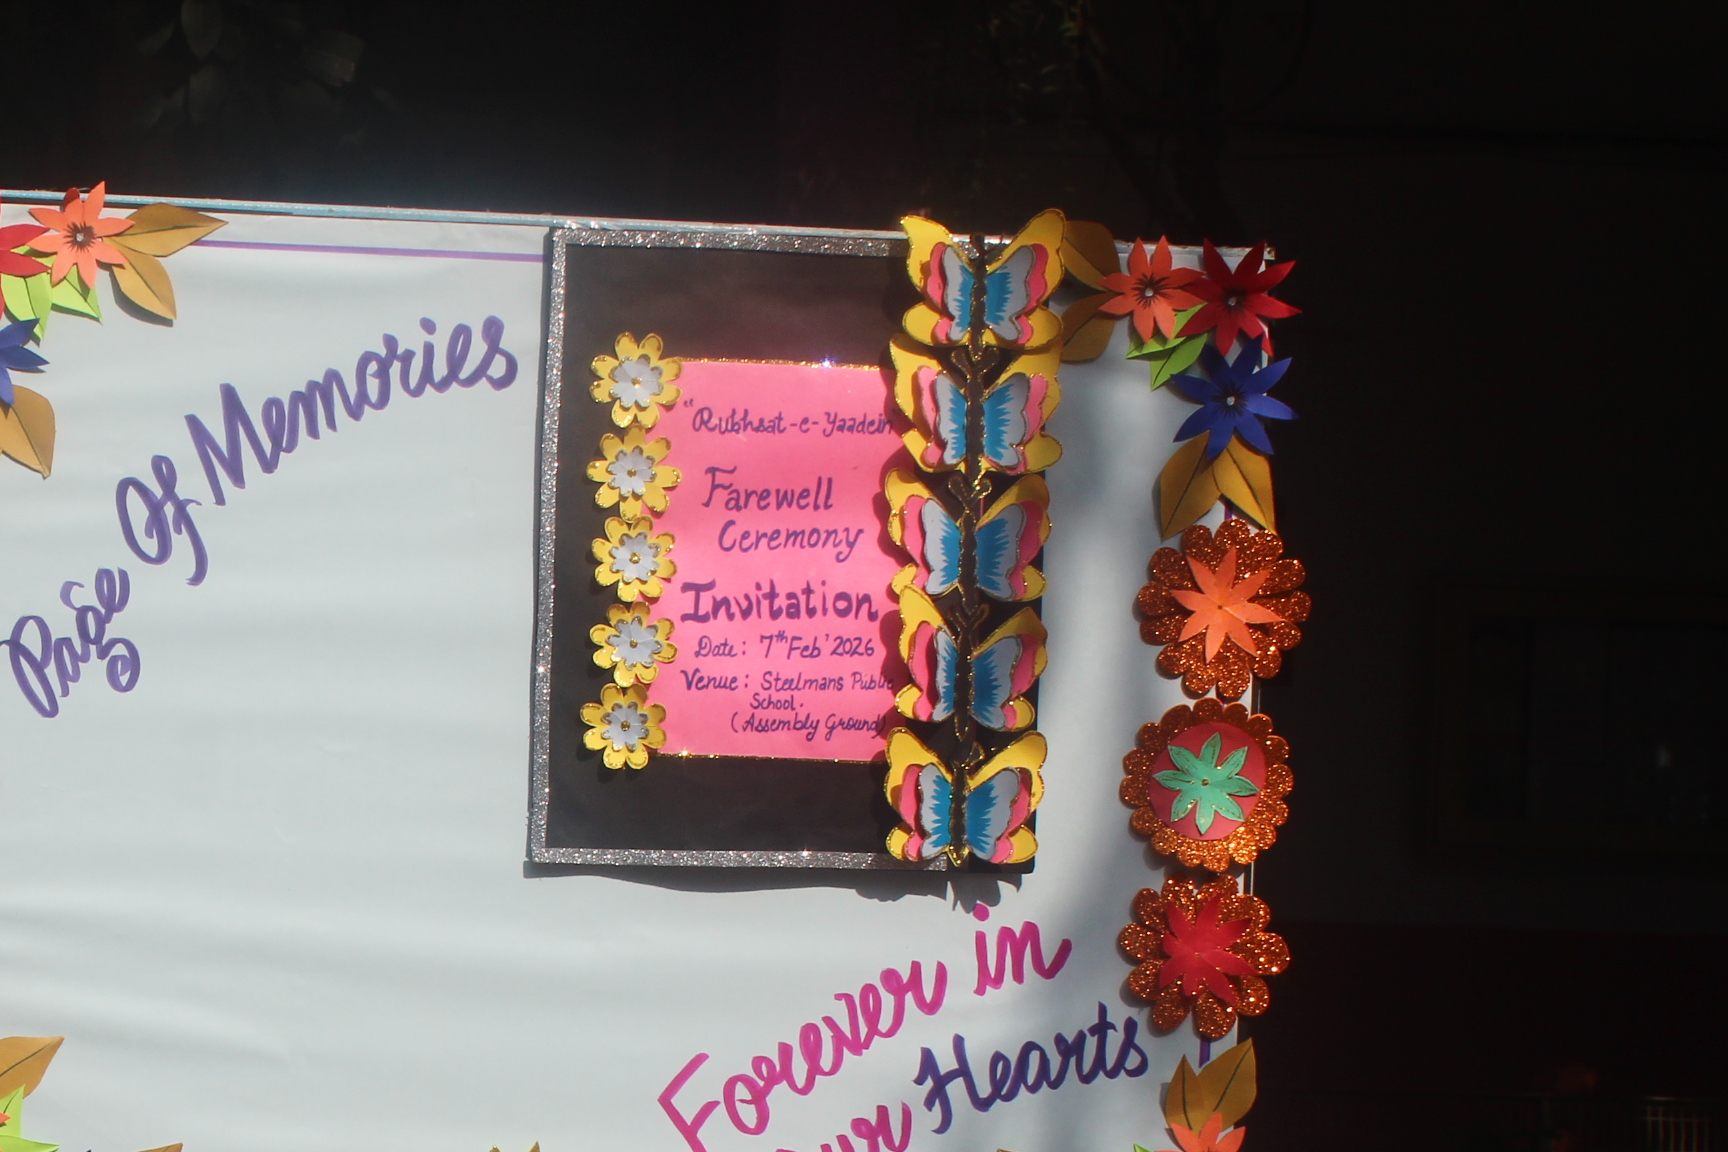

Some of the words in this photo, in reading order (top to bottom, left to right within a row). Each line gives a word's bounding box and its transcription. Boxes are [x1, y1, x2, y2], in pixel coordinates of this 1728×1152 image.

[116, 455, 208, 585] Of
[184, 316, 517, 506] Memories
[702, 466, 833, 512] Farewell
[718, 520, 864, 563] Ceremony
[680, 579, 878, 623] Invitation
[761, 671, 844, 691] Steelmans
[851, 671, 895, 691] Public
[973, 903, 1072, 996] in
[912, 1001, 1149, 1134] Hearts
